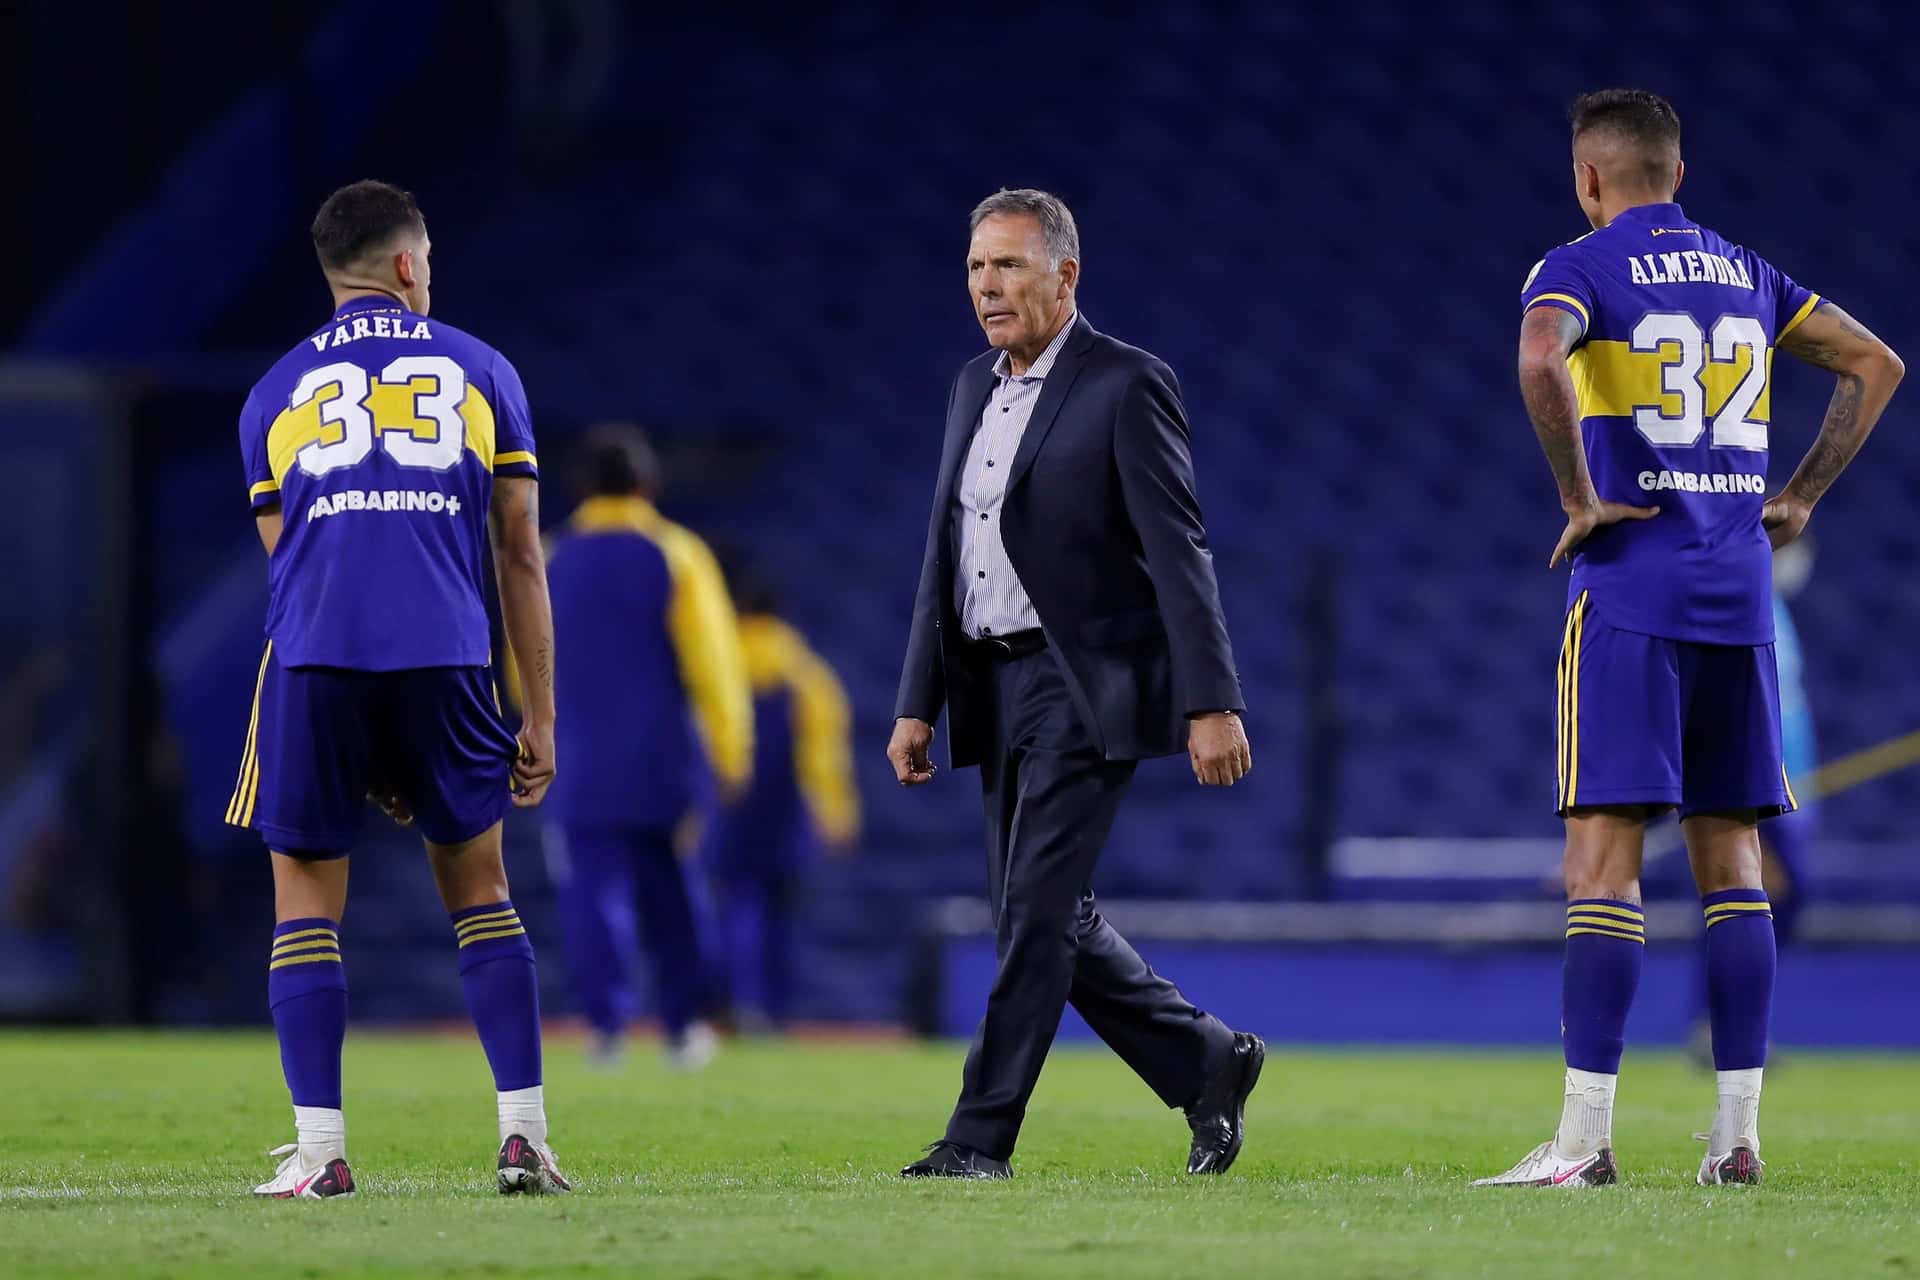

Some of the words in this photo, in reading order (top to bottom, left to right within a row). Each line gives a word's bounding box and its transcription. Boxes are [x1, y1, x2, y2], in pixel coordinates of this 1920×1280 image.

[1628, 250, 1754, 290] ALMENDRA
[311, 316, 432, 352] VARELA
[1629, 311, 1768, 452] 32
[290, 355, 466, 479] 33
[1638, 470, 1766, 494] GARBARINO
